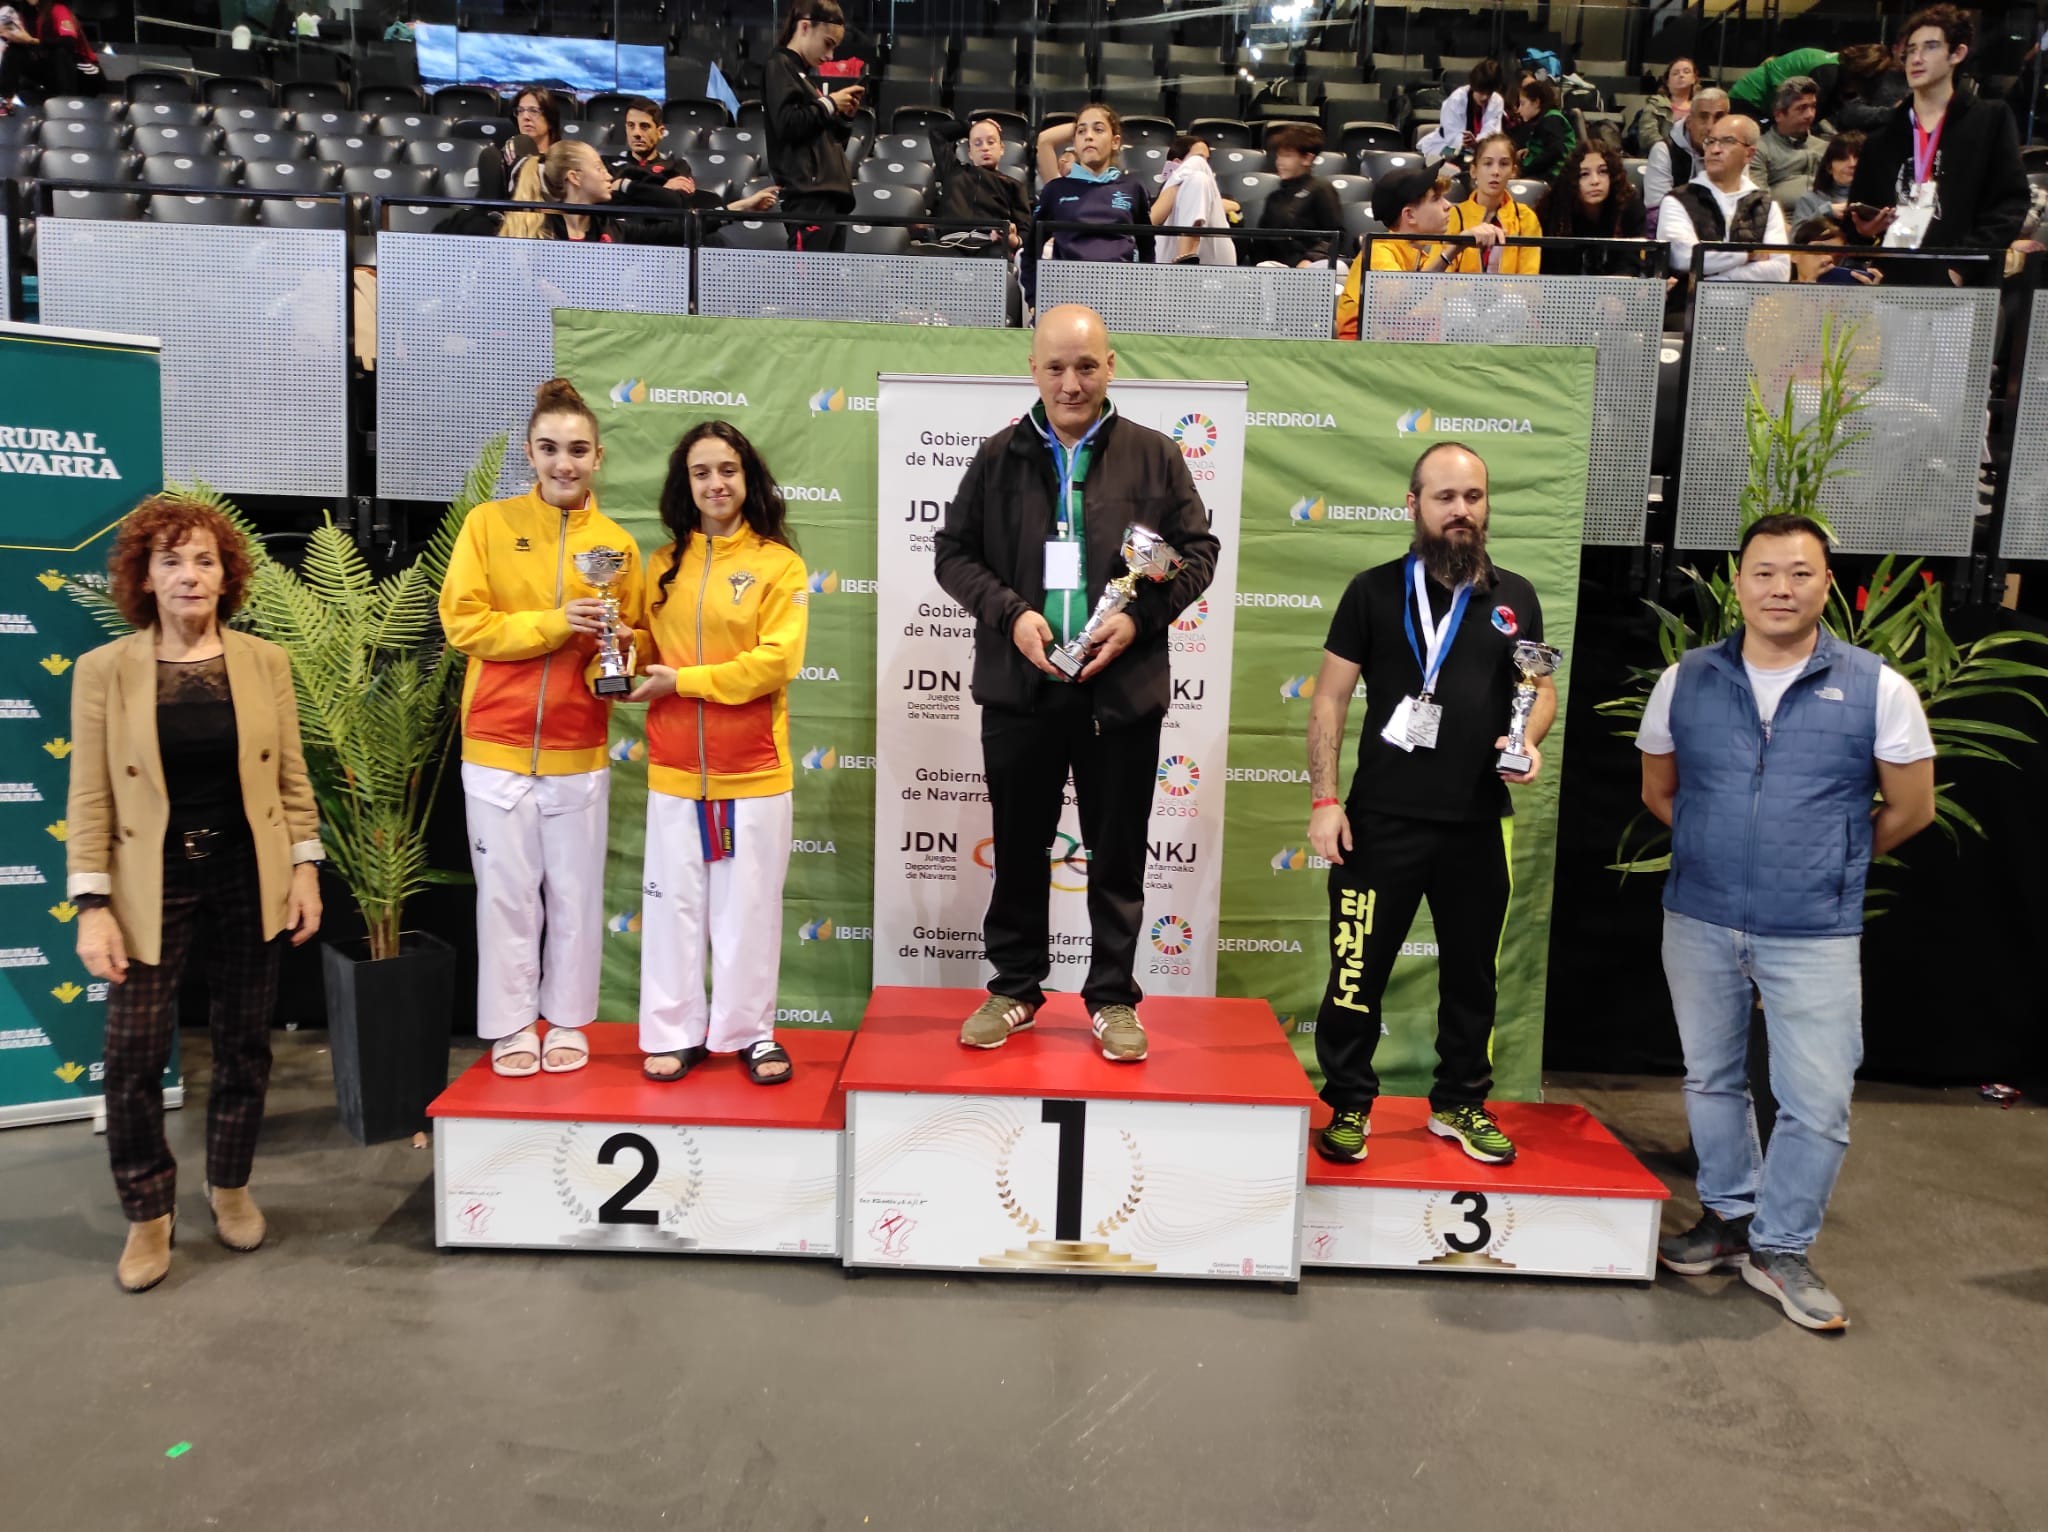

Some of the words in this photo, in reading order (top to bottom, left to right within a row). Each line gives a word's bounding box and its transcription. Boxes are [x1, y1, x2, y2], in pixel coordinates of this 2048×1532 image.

[649, 387, 748, 407] IBERDROLA
[847, 396, 880, 411] IBE
[1434, 417, 1533, 434] IBERDROLA
[0, 425, 106, 455] RURAL
[905, 452, 926, 466] de
[1328, 505, 1413, 522] IBERDROL
[918, 603, 971, 618] Gobie
[903, 623, 924, 637] de
[903, 669, 960, 692] JDN
[907, 701, 960, 711] Deportivos
[927, 694, 960, 703] Juegos
[907, 711, 920, 719] de
[921, 711, 960, 720] Navarra
[901, 787, 921, 800] de
[926, 787, 992, 803] Navarra
[1156, 806, 1199, 818] 2030
[900, 831, 957, 853] JDN
[924, 854, 957, 863] Juegos
[1145, 840, 1197, 864] NKJ
[904, 862, 957, 872] Deportivos
[919, 872, 957, 880] Navarra
[898, 945, 919, 957] de
[924, 945, 987, 960] Navarra
[1332, 888, 1377, 1013] 태권도
[1398, 942, 1440, 956] BER
[1150, 964, 1191, 976] 2030
[1041, 1099, 1087, 1241] 1
[597, 1132, 660, 1226] 2
[1443, 1190, 1492, 1254] 3
